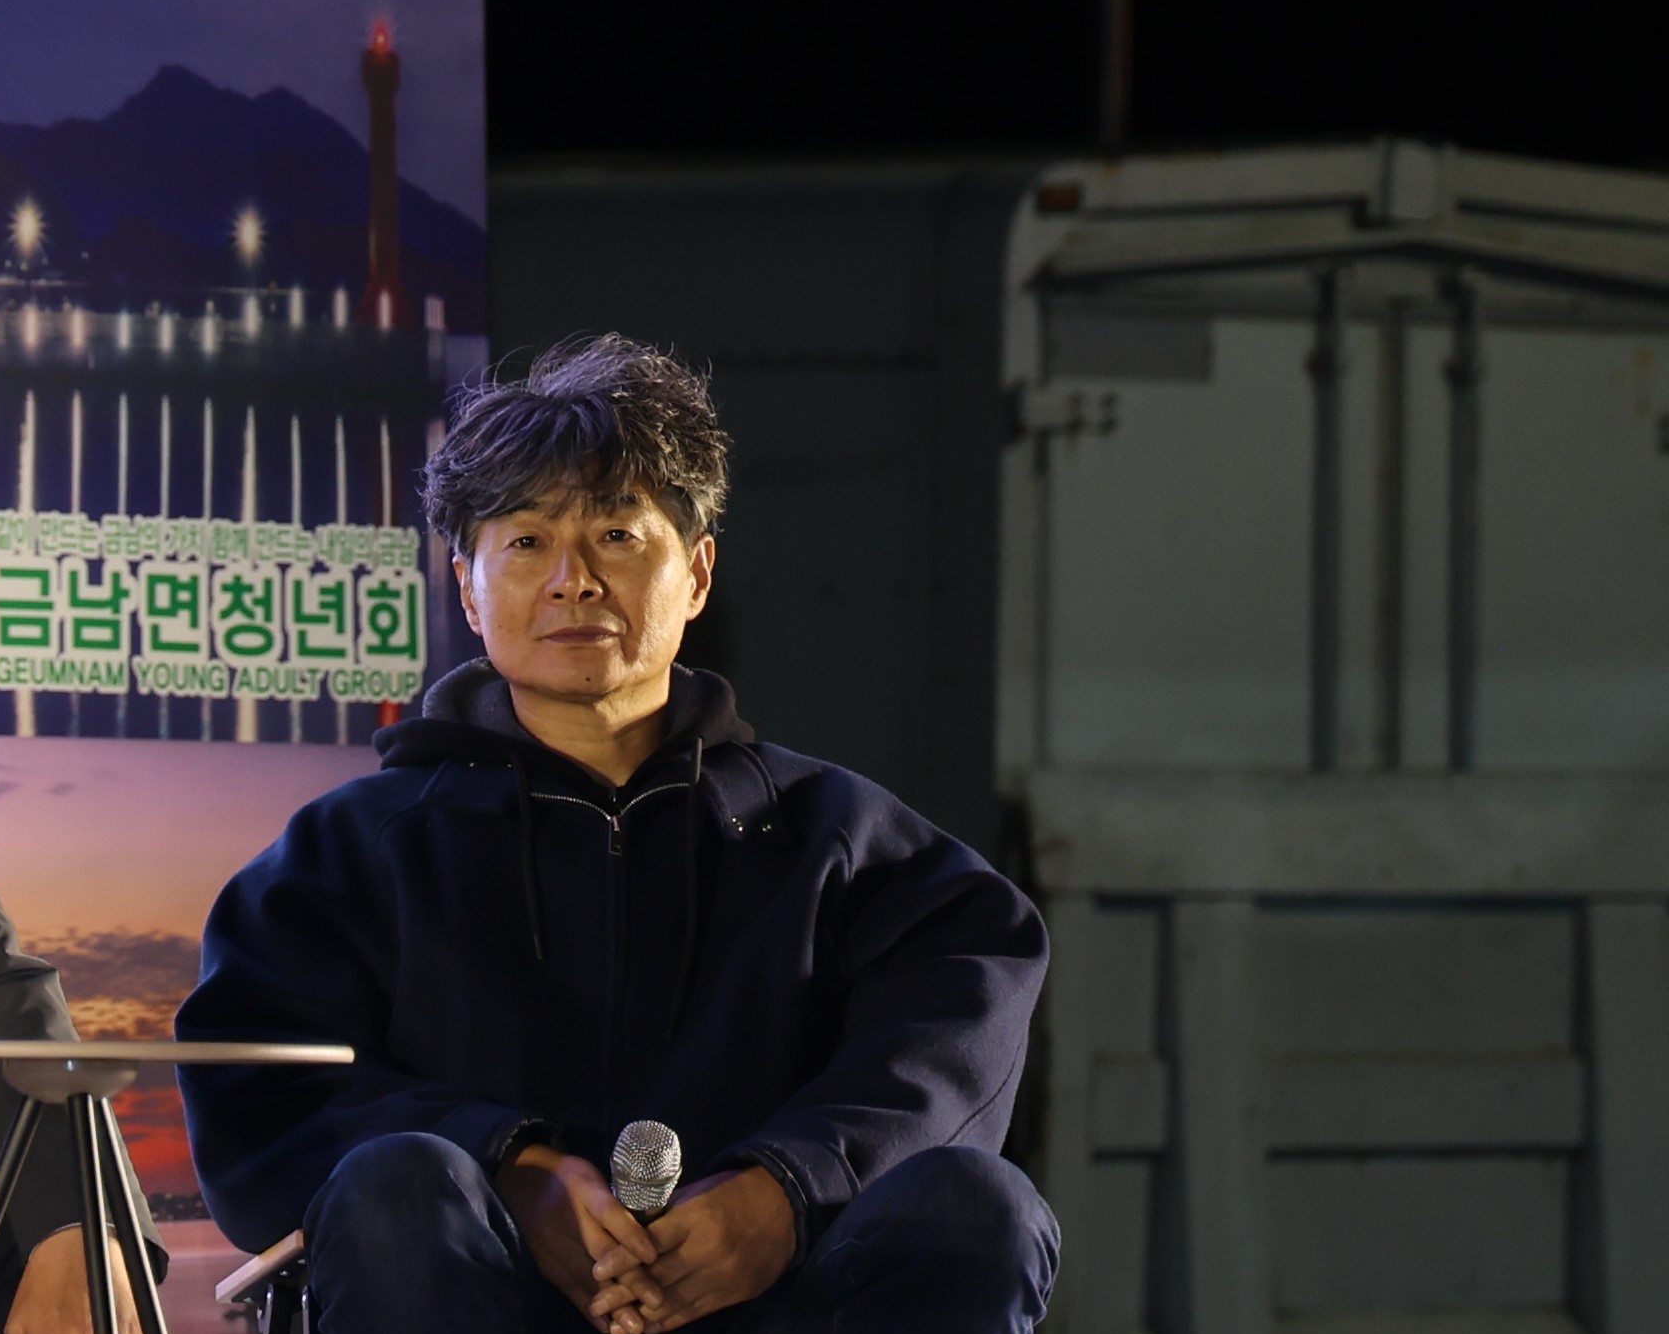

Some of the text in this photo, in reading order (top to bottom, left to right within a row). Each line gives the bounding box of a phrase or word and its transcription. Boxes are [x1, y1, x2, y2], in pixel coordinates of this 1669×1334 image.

[134, 660, 226, 691] YOUNG
[238, 666, 321, 694] ADULT
[331, 669, 418, 697] GROUP
